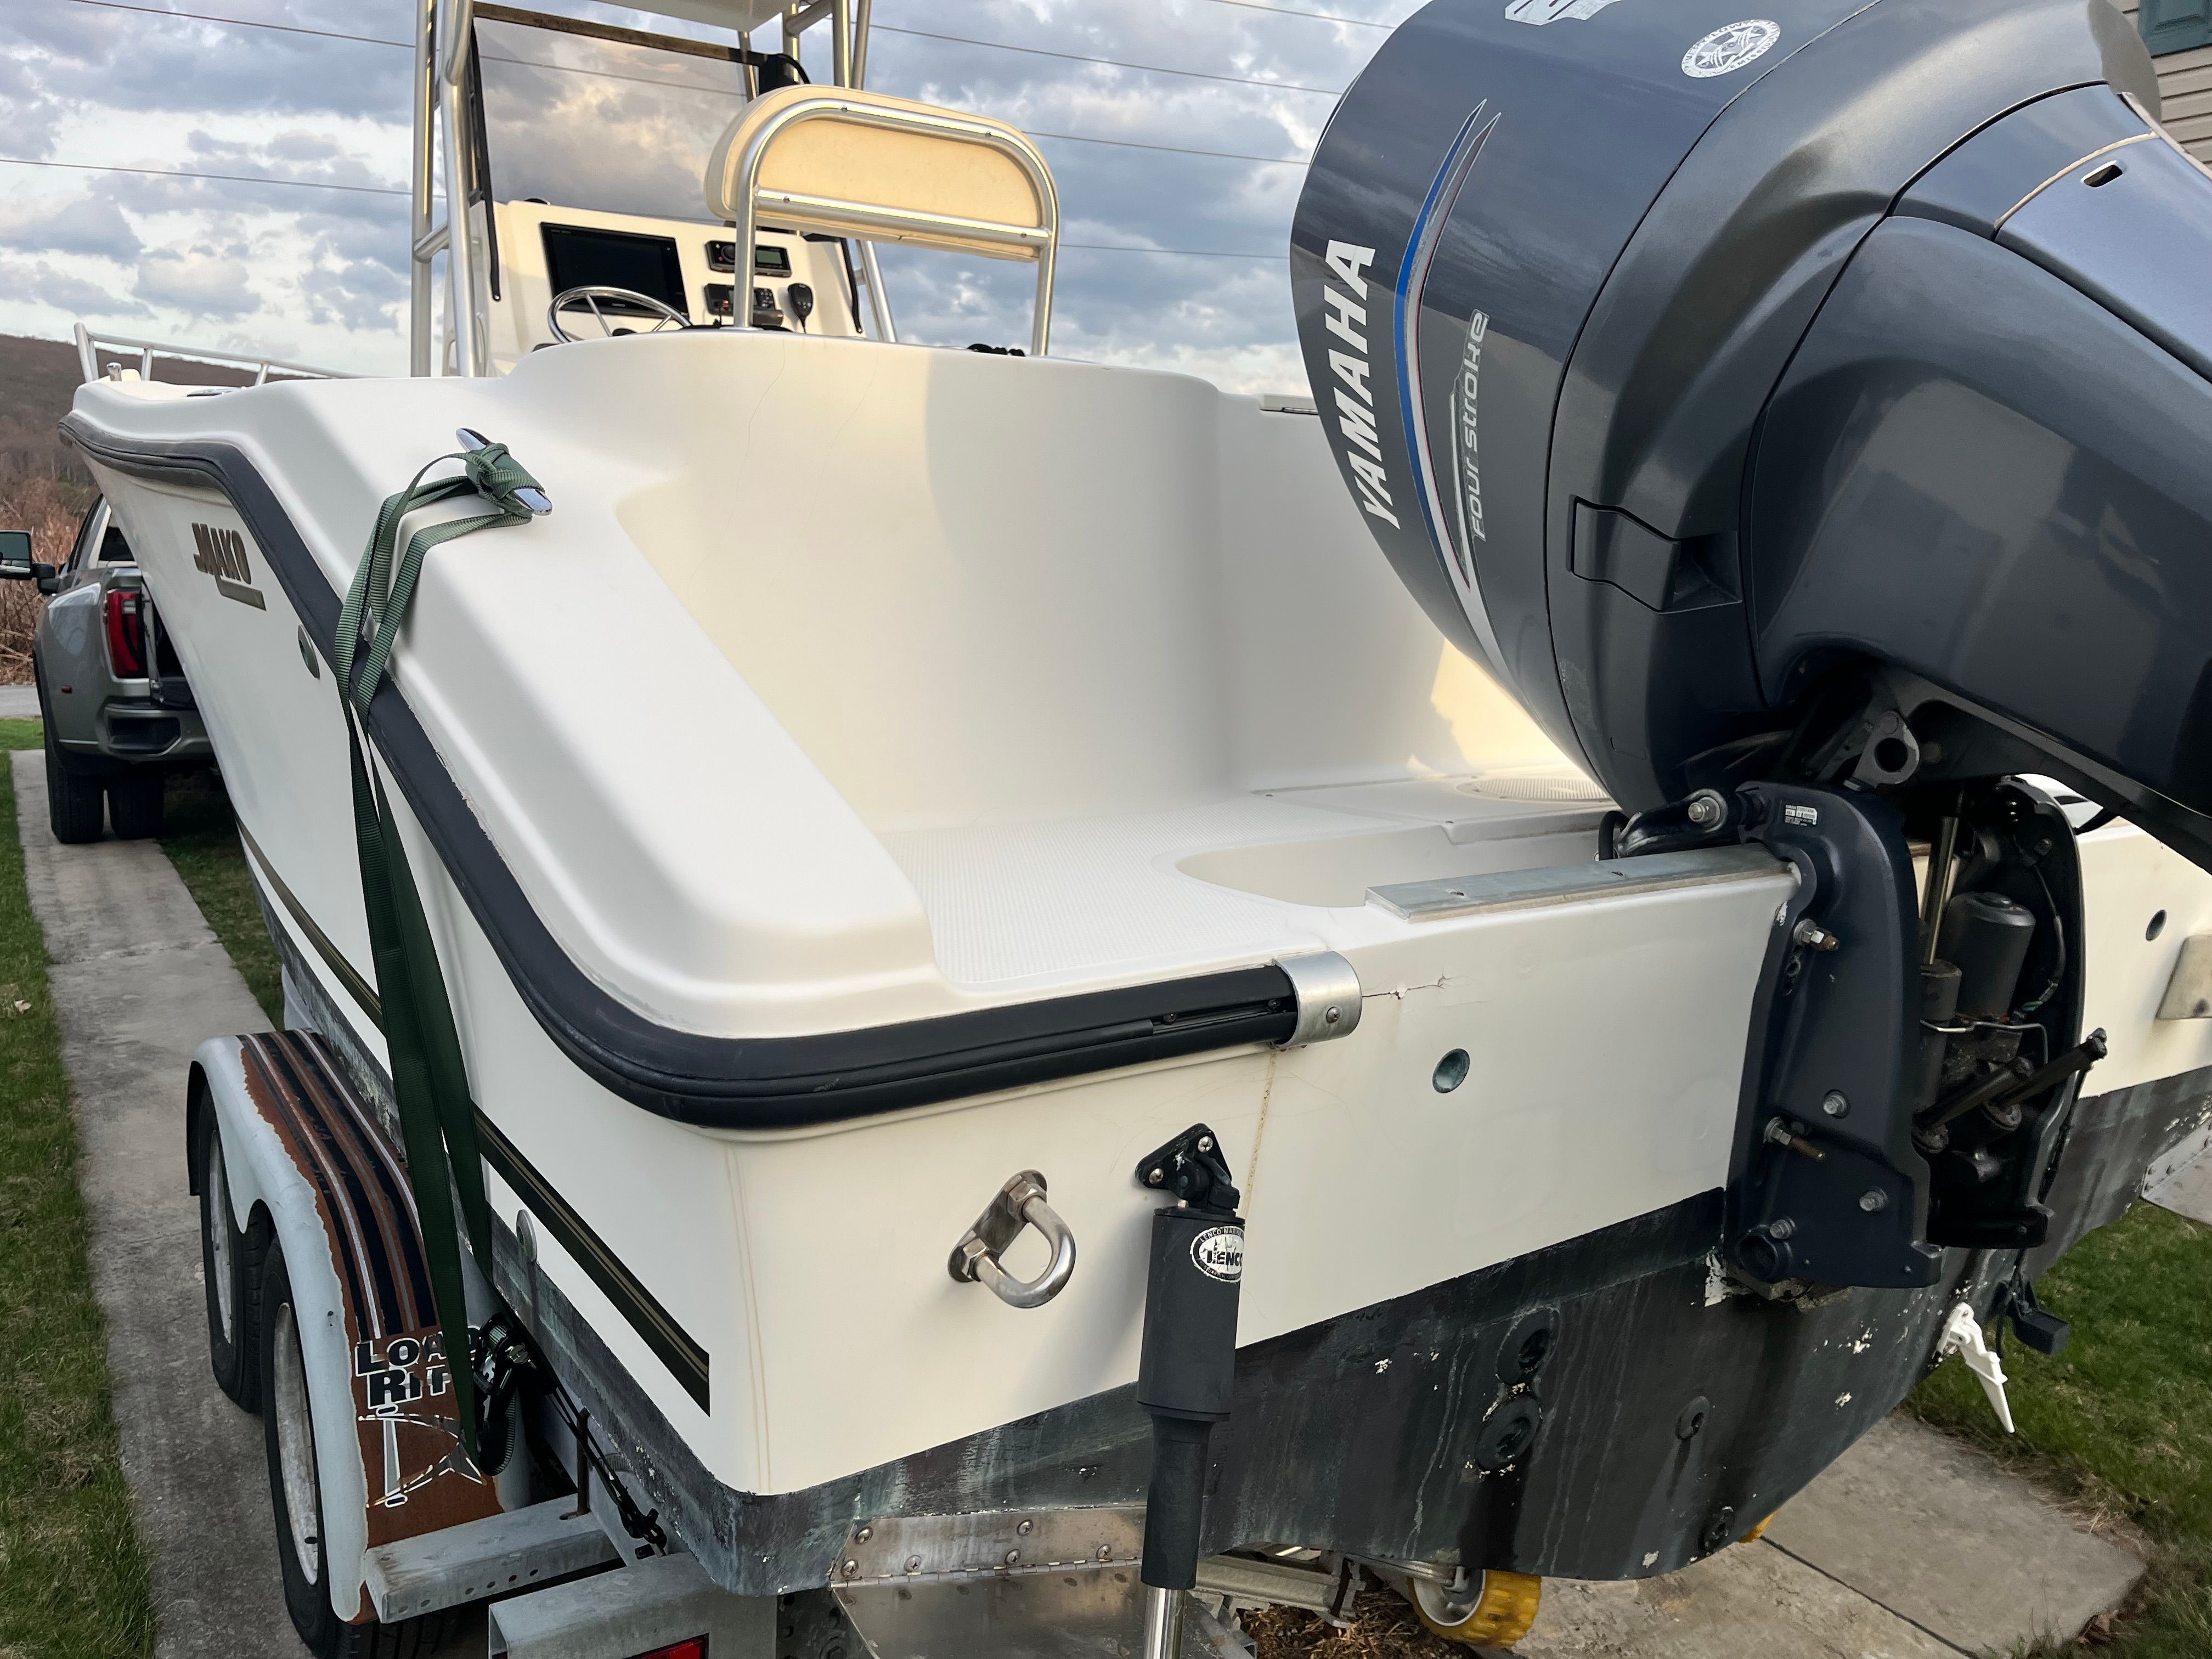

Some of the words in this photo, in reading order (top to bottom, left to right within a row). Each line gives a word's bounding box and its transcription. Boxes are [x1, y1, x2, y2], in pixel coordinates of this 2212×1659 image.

[1712, 22, 1742, 36] LOW
[1324, 239, 1401, 531] YAMAHA
[191, 523, 258, 595] MAKO
[1199, 1228, 1221, 1243] LENCO
